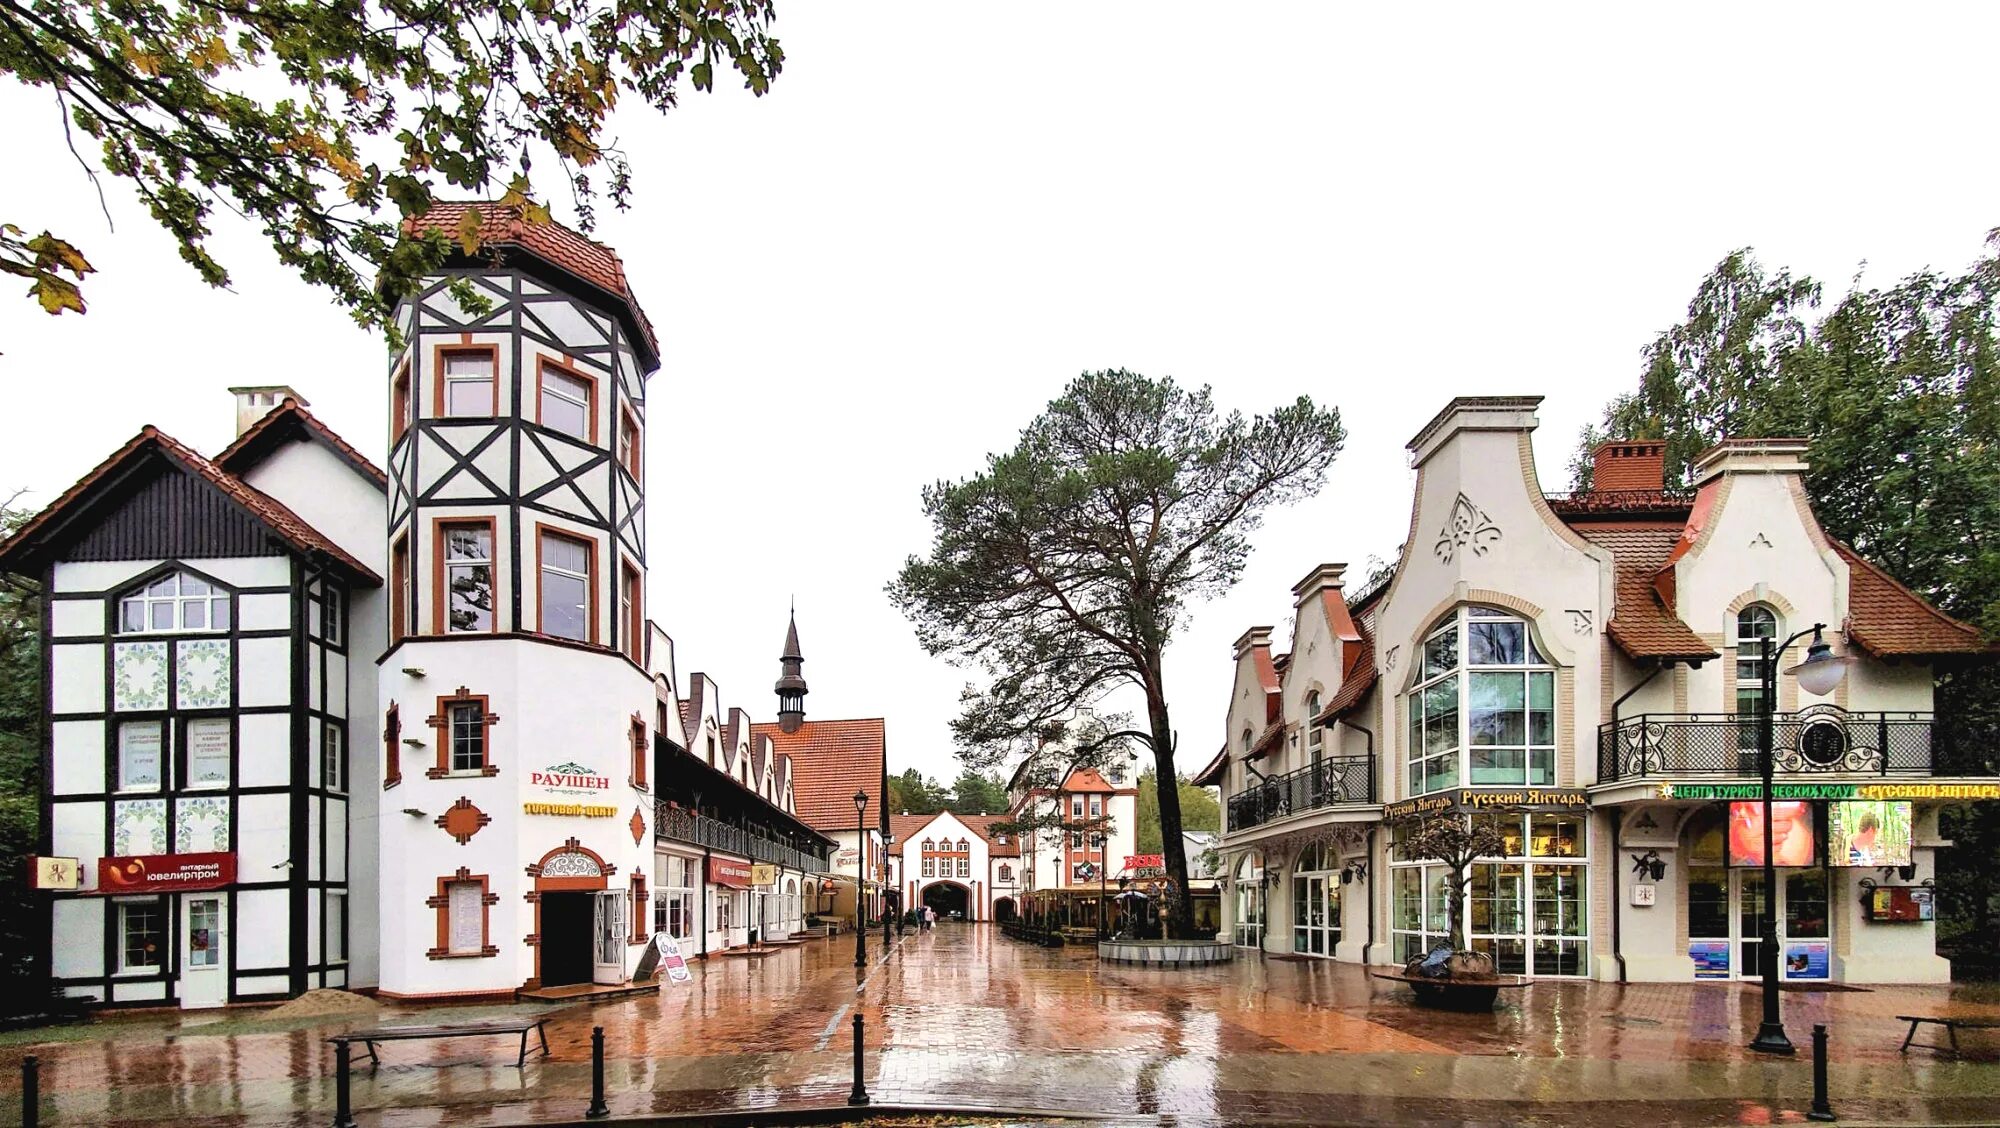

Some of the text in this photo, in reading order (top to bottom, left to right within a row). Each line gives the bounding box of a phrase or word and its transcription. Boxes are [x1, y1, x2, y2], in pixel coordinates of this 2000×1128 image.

[531, 772, 609, 789] РАУШЕН
[1461, 790, 1585, 809] Русский Янтарь
[1674, 786, 1714, 798] ЦЕНТР
[1715, 786, 1818, 798] ТУРИСТЧЕСКИХ
[1869, 784, 1999, 800] РУССКИЙ ЯНТАРЬ
[524, 803, 617, 818] ТОРГОВЫЙ ЦЕНТР
[1384, 797, 1452, 820] Русский Янтарь
[180, 863, 219, 871] янтарный
[147, 870, 219, 882] ювелирпром
